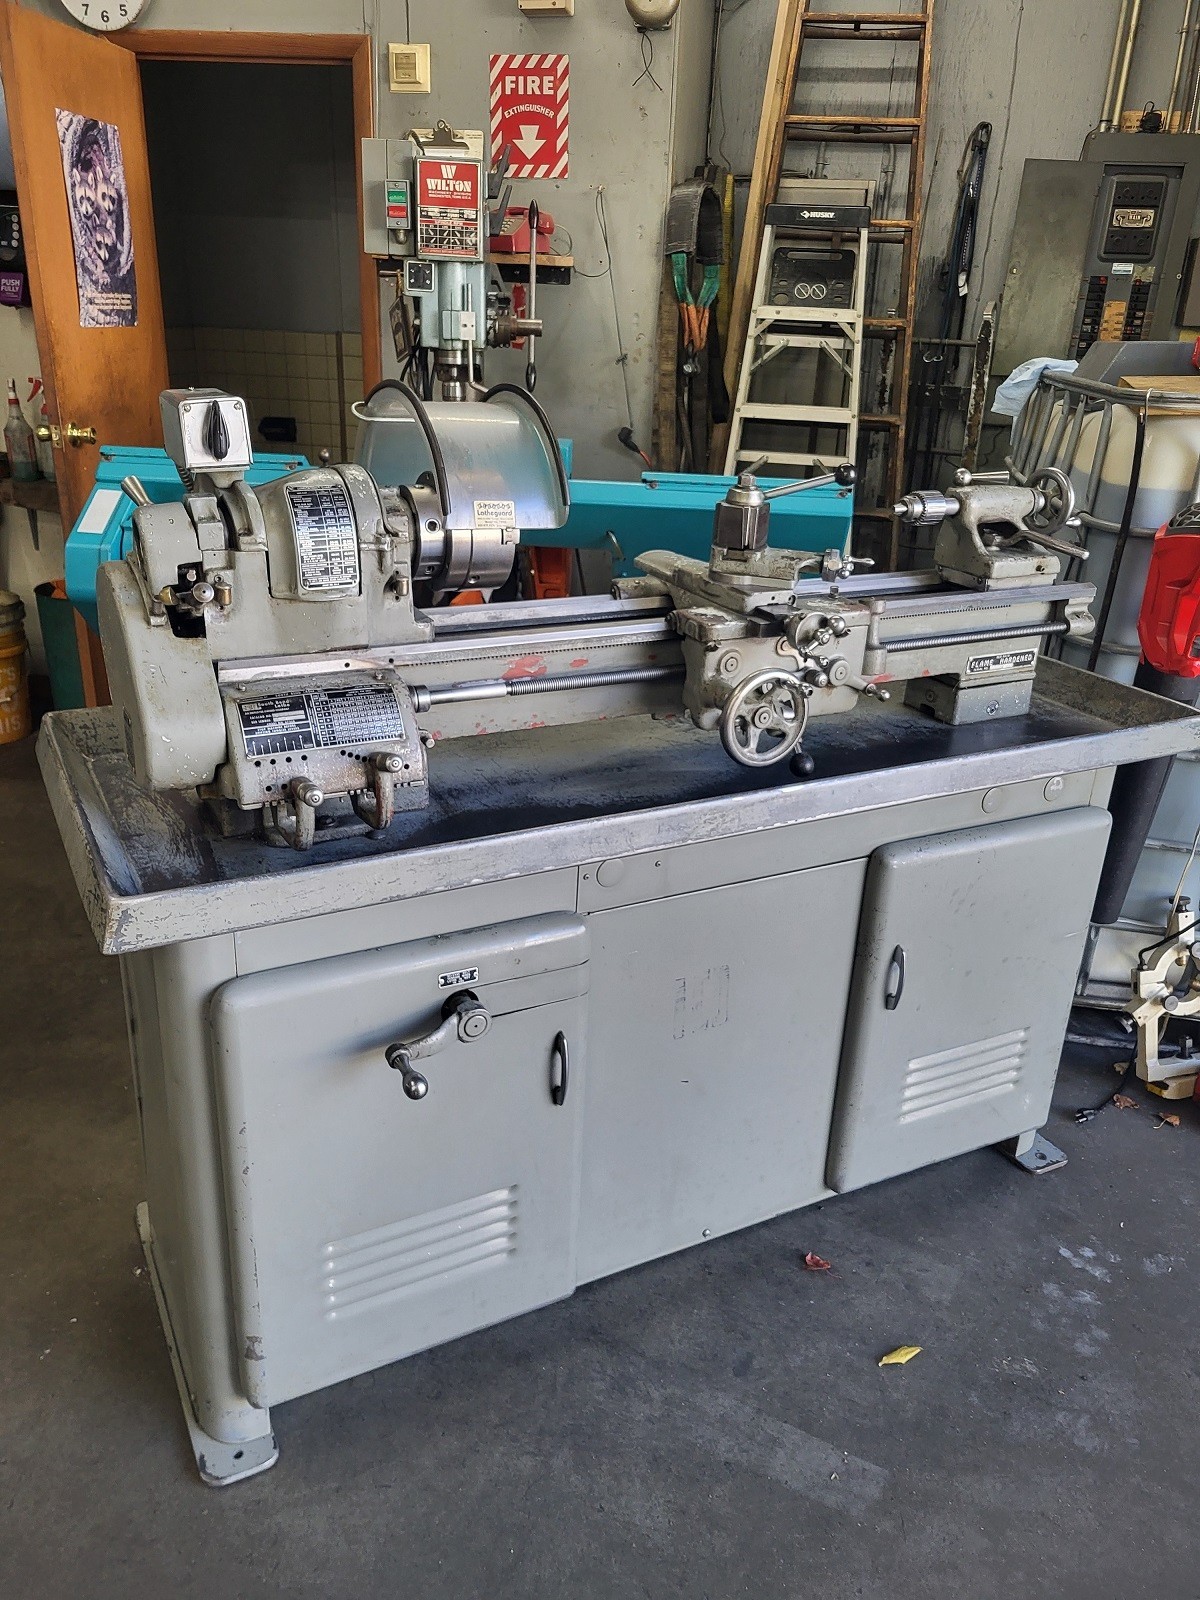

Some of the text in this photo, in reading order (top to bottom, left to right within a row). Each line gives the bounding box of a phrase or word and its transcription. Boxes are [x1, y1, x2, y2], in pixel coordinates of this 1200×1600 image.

[82, 3, 90, 16] 7
[101, 10, 110, 23] 6
[119, 3, 128, 17] 5
[505, 75, 555, 95] FIRE
[503, 103, 555, 119] EXTINGUISHER
[440, 164, 457, 179] W
[426, 178, 472, 192] WILTON
[971, 659, 994, 668] FLAME
[1000, 654, 1033, 664] HARDENED
